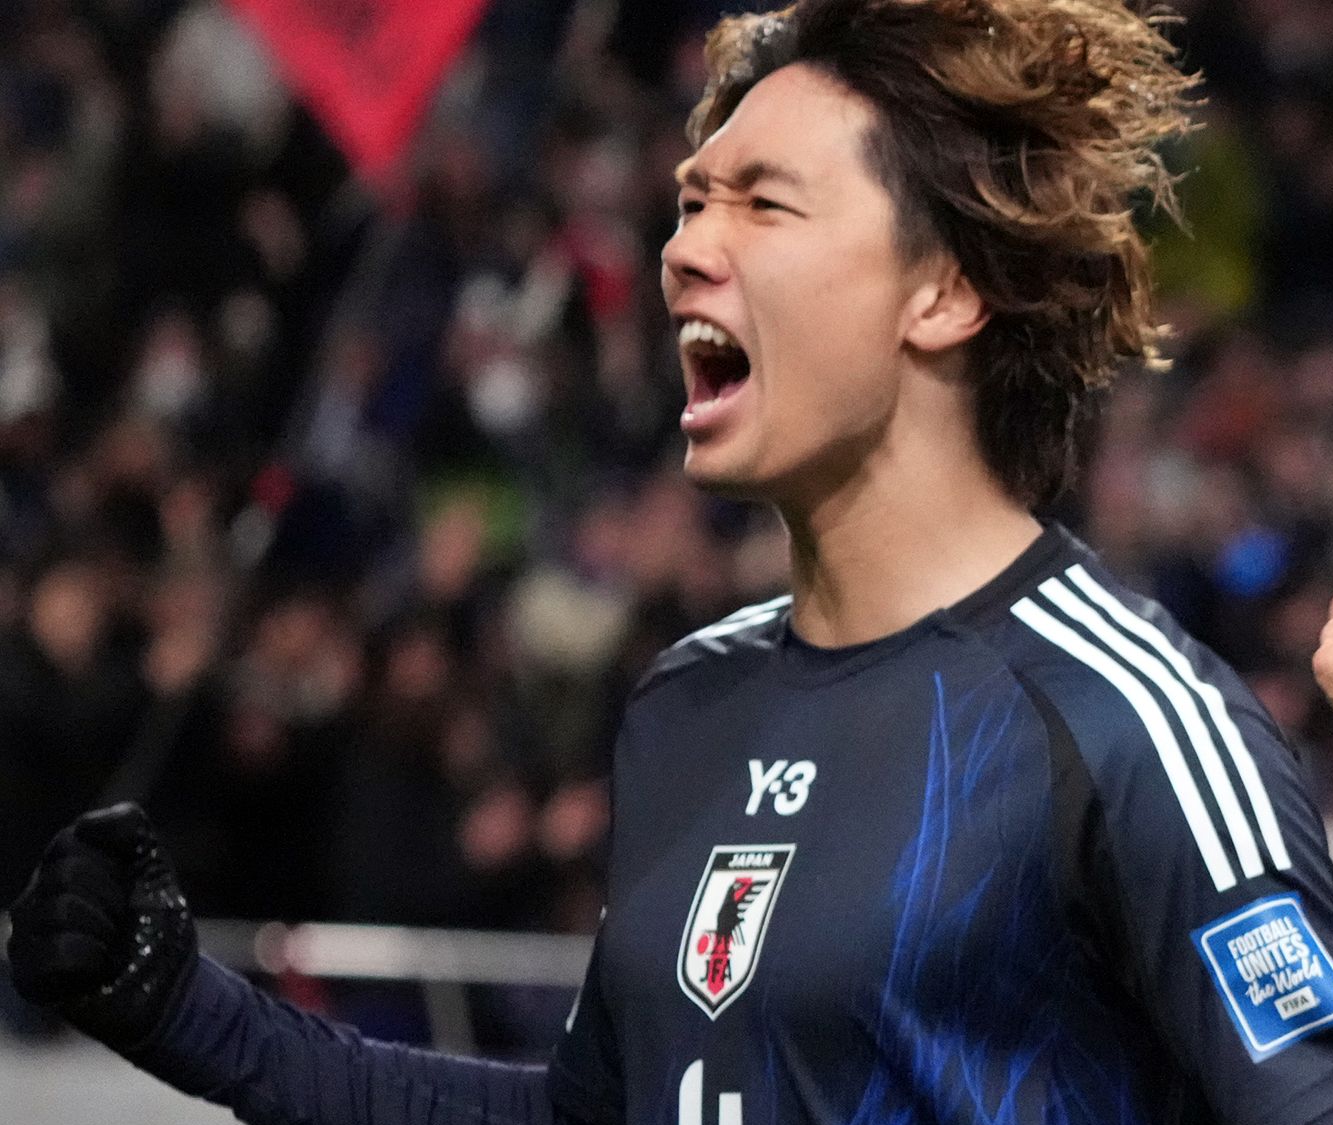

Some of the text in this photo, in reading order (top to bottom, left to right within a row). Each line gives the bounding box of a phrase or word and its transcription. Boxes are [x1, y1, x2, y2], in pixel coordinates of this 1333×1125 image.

[745, 759, 817, 816] Y-3
[728, 853, 774, 868] JAPAN
[1227, 917, 1298, 959] FOOTBALL
[699, 958, 732, 983] JFA
[1236, 933, 1310, 983] UNITES
[1272, 955, 1323, 994] World
[1281, 995, 1309, 1013] FIFA
